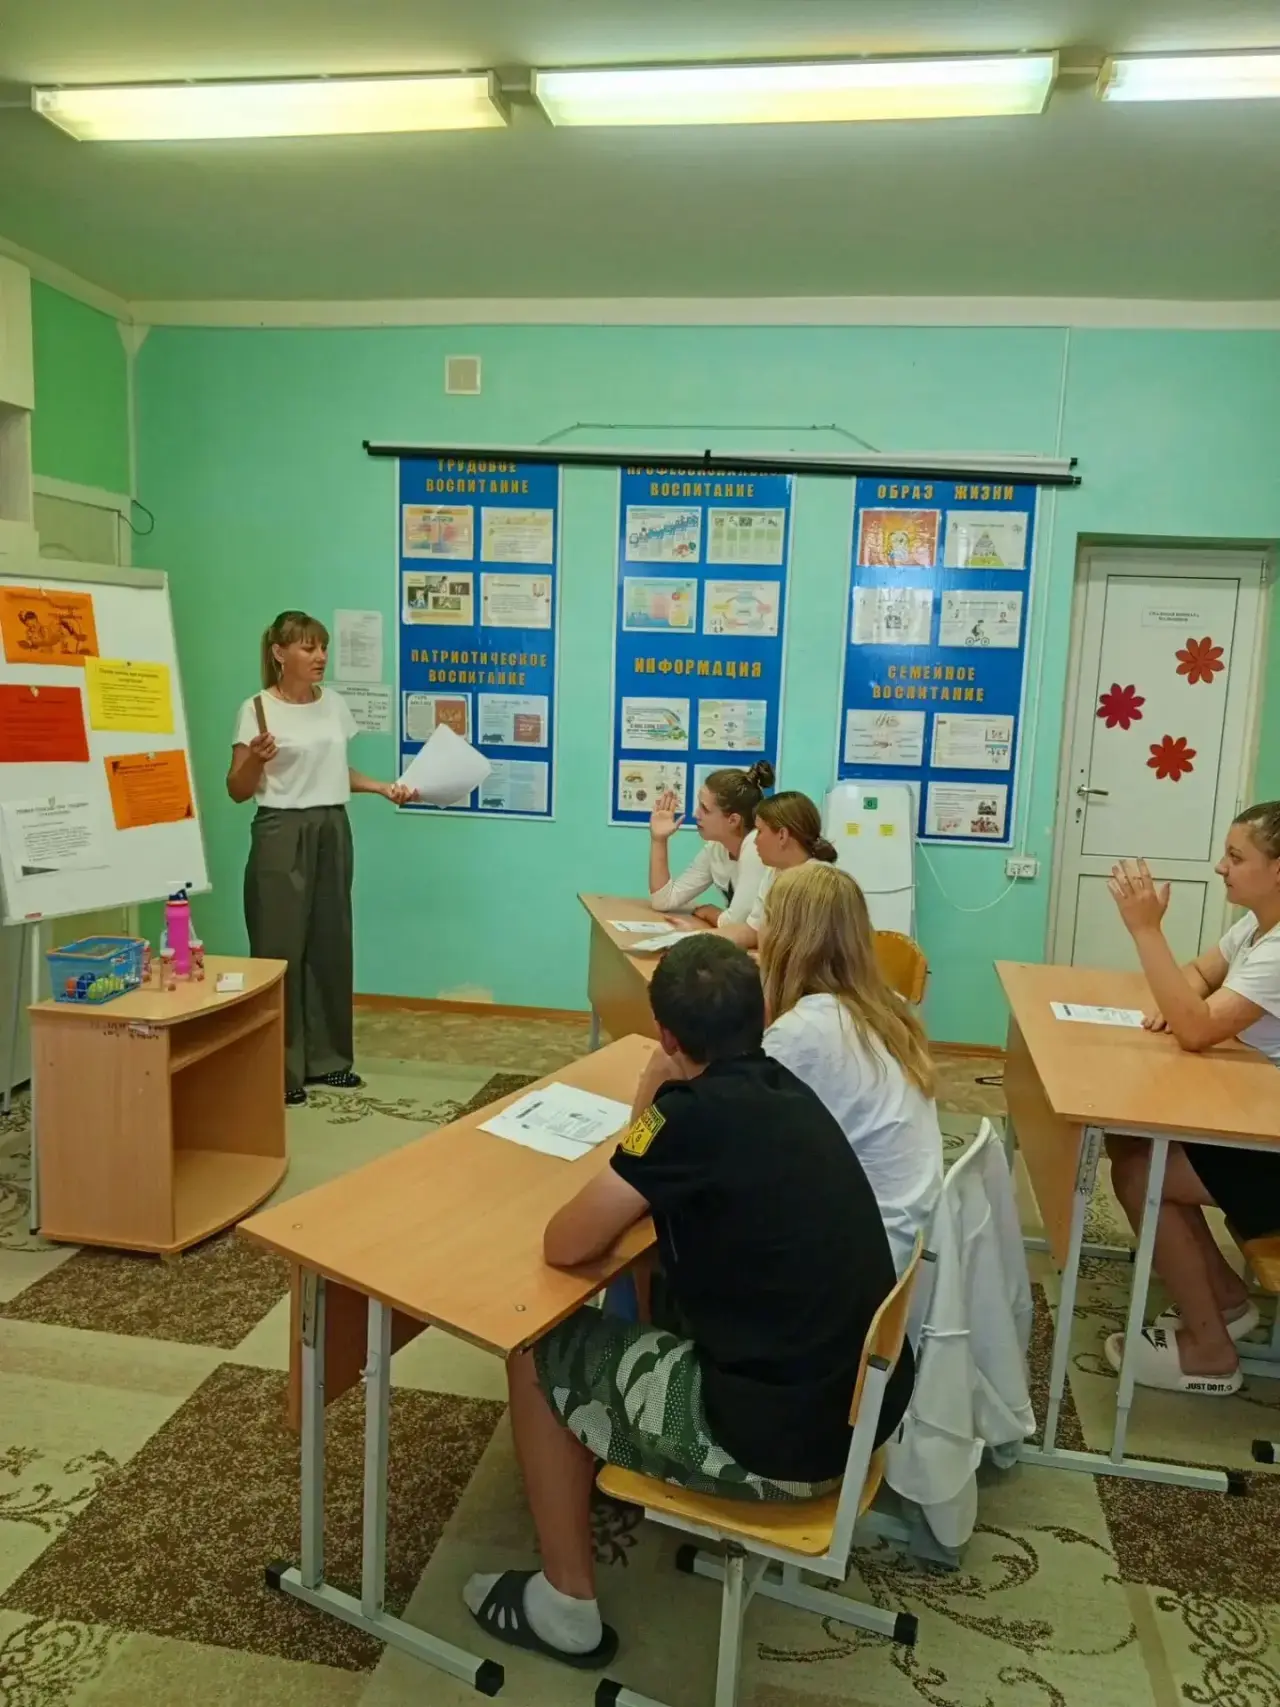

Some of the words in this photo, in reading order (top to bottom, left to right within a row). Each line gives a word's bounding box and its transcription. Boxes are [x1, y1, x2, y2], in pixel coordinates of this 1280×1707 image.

[426, 478, 529, 494] ВОСПИТАНИЕ
[651, 482, 754, 497] ВОСПИТАНИЕ
[877, 484, 933, 500] ОБРАЗ
[954, 485, 1014, 500] ЖИЗНИ
[411, 649, 547, 667] ПАТРИОТИЧЕСКОЕ
[634, 657, 761, 679] ИНФОРМАЦИЯ
[887, 662, 975, 681] СЕМЕЙНОЕ
[428, 669, 526, 686] ВОСПИТАНИЕ
[872, 684, 984, 702] ВОСПИТАНИЕ
[1185, 1382, 1205, 1391] JUST
[1206, 1383, 1217, 1392] DO
